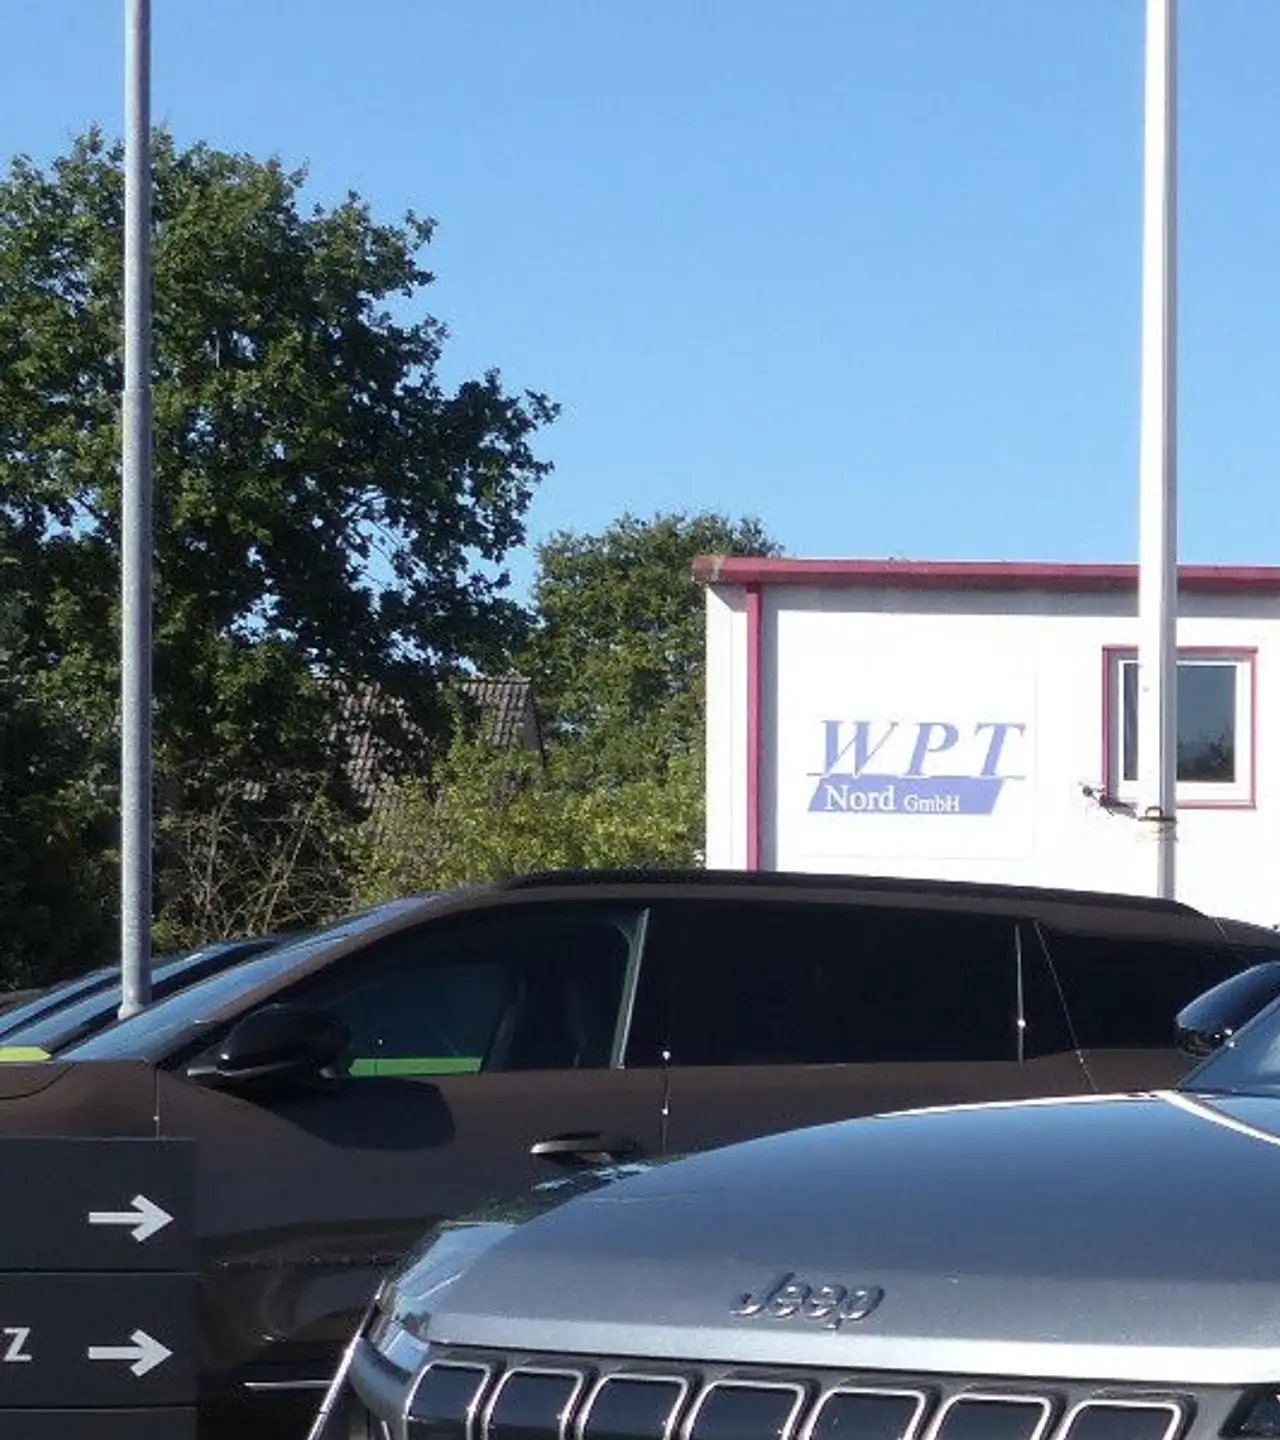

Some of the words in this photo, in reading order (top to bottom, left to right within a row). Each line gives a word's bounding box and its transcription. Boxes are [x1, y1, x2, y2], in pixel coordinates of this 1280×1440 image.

[824, 784, 897, 812] Nord
[904, 792, 960, 813] GmbH
[730, 1271, 885, 1331] Jeep
